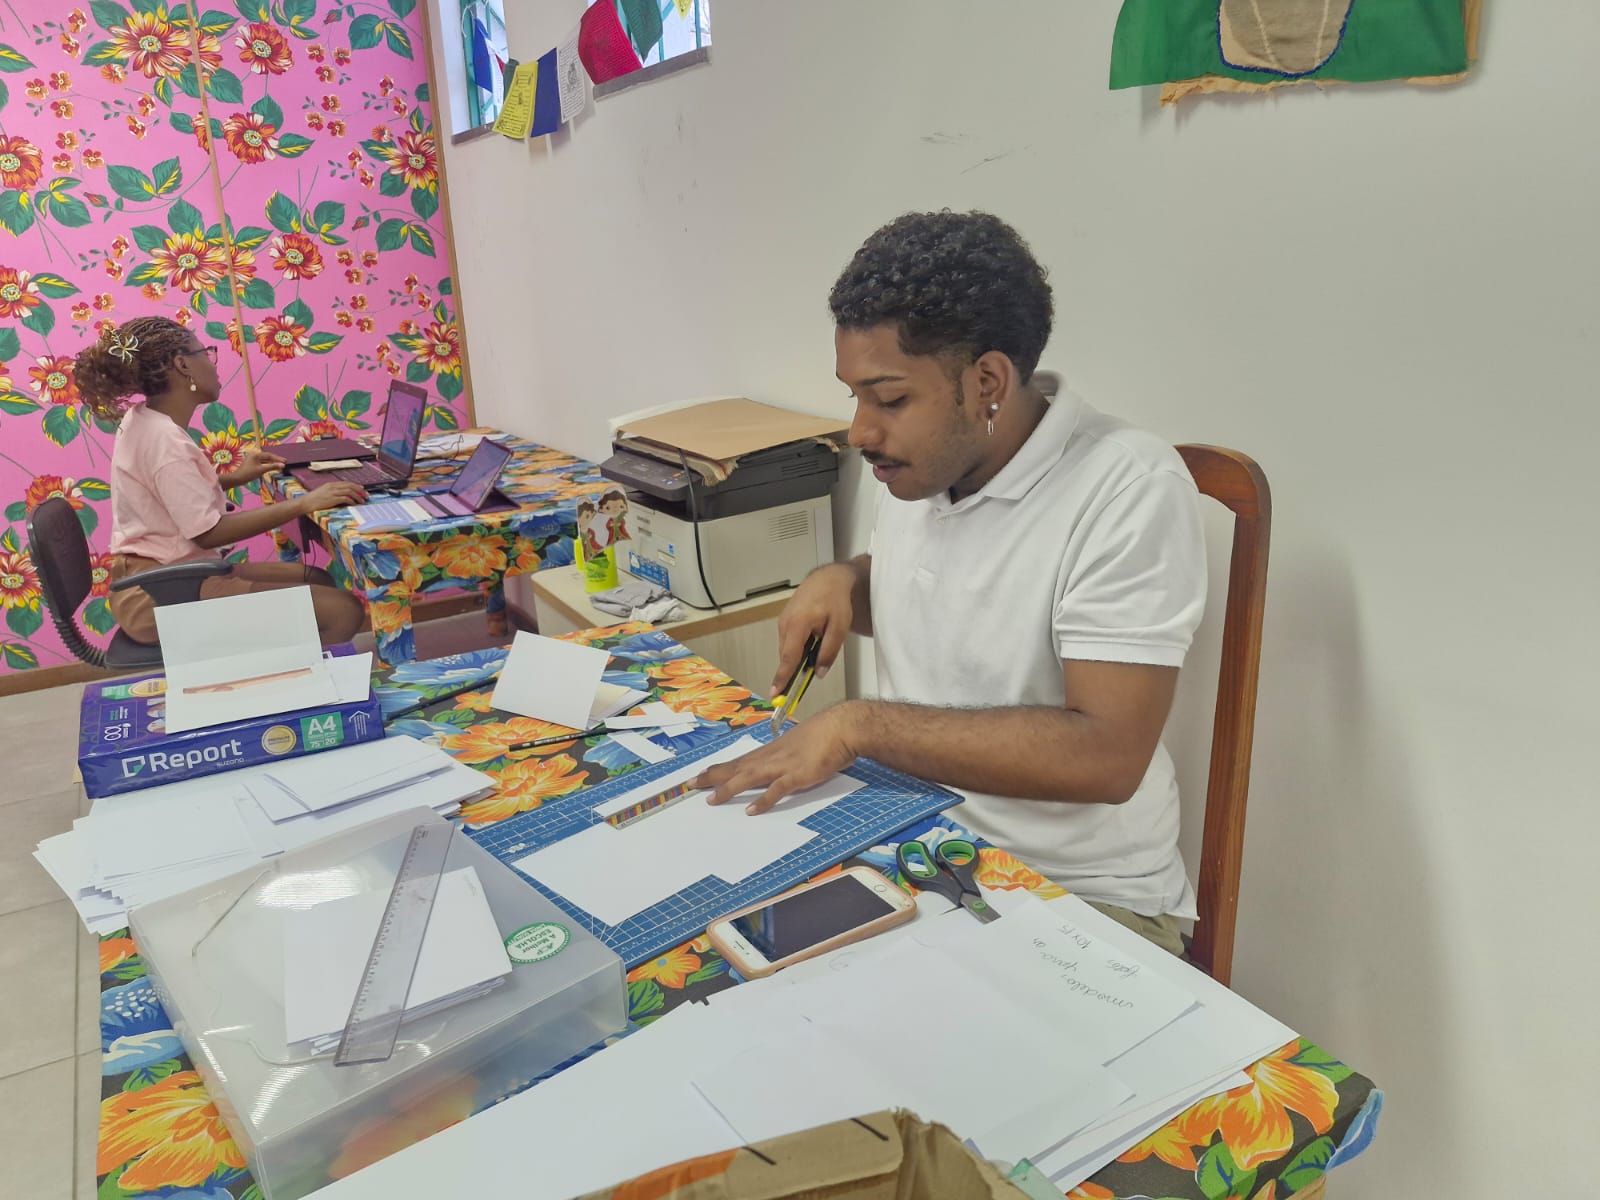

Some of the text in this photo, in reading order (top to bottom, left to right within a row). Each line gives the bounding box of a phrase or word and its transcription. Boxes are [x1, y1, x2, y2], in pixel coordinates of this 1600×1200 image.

[308, 715, 337, 735] A4
[149, 739, 243, 773] Report
[216, 757, 245, 768] suzano
[515, 928, 552, 949] ESCOLHA
